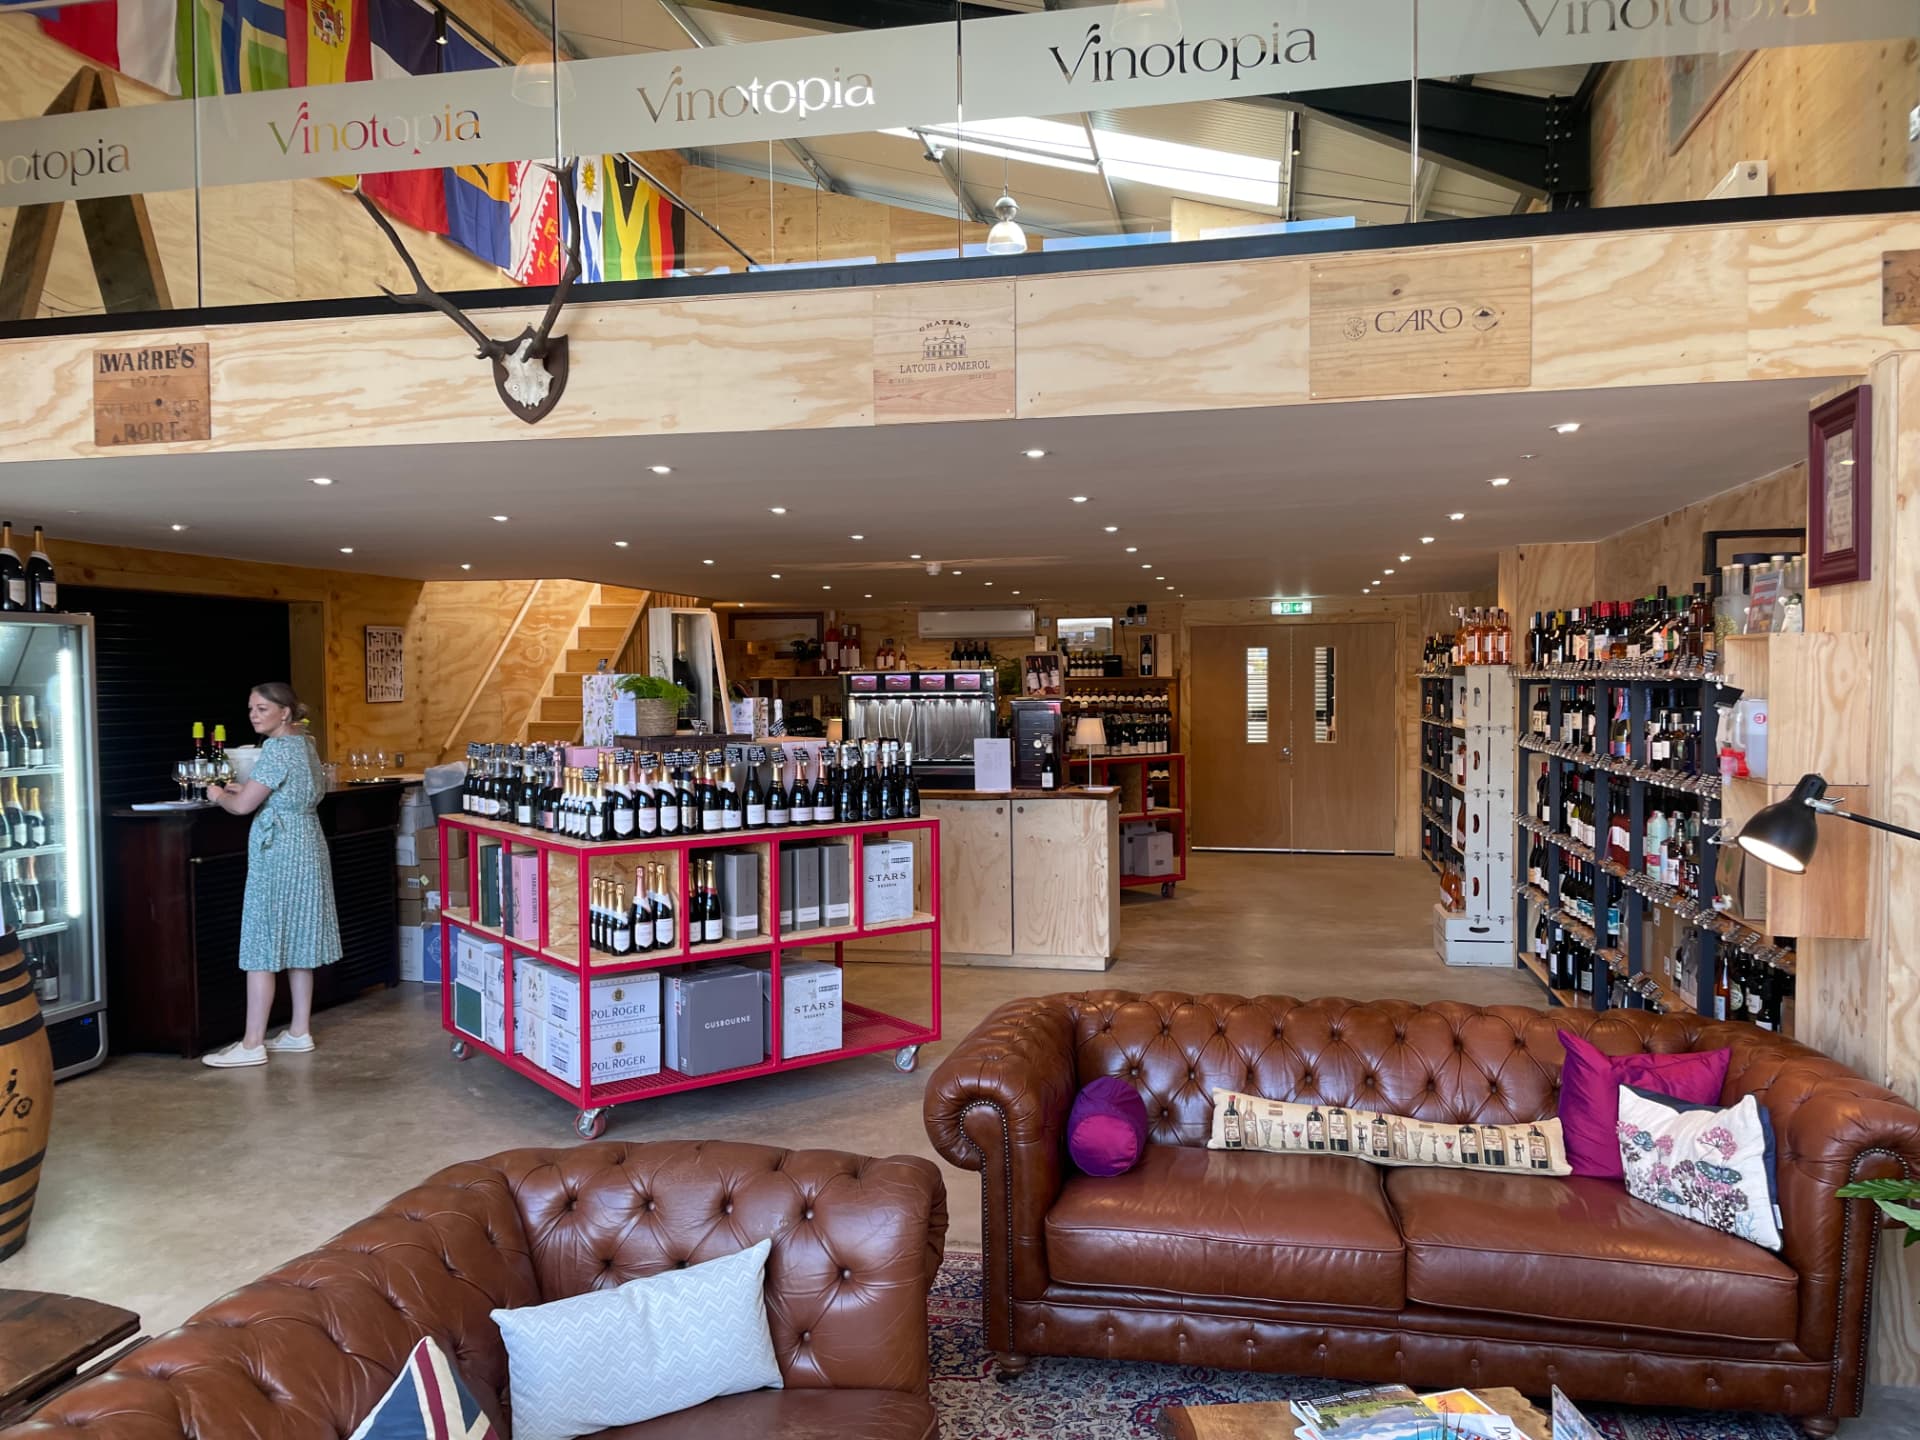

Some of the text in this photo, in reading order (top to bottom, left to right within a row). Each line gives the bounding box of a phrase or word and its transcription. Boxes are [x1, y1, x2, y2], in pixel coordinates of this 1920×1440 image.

[1048, 22, 1318, 87] Vinotopia
[635, 65, 877, 125] Vinotopia
[267, 101, 482, 156] Vinotopia
[0, 138, 130, 187] otopia
[918, 319, 971, 333] CHATEAU
[1374, 306, 1464, 334] CARO
[98, 345, 197, 374] WARRE'S
[900, 363, 936, 374] LATOUR
[945, 360, 991, 372] POMEROL
[867, 871, 907, 882] STARS
[592, 1003, 646, 1020] POL ROGER
[793, 1000, 835, 1015] STARS
[704, 1015, 751, 1030] GUSBOURNE
[592, 1055, 646, 1072] POL ROGER
